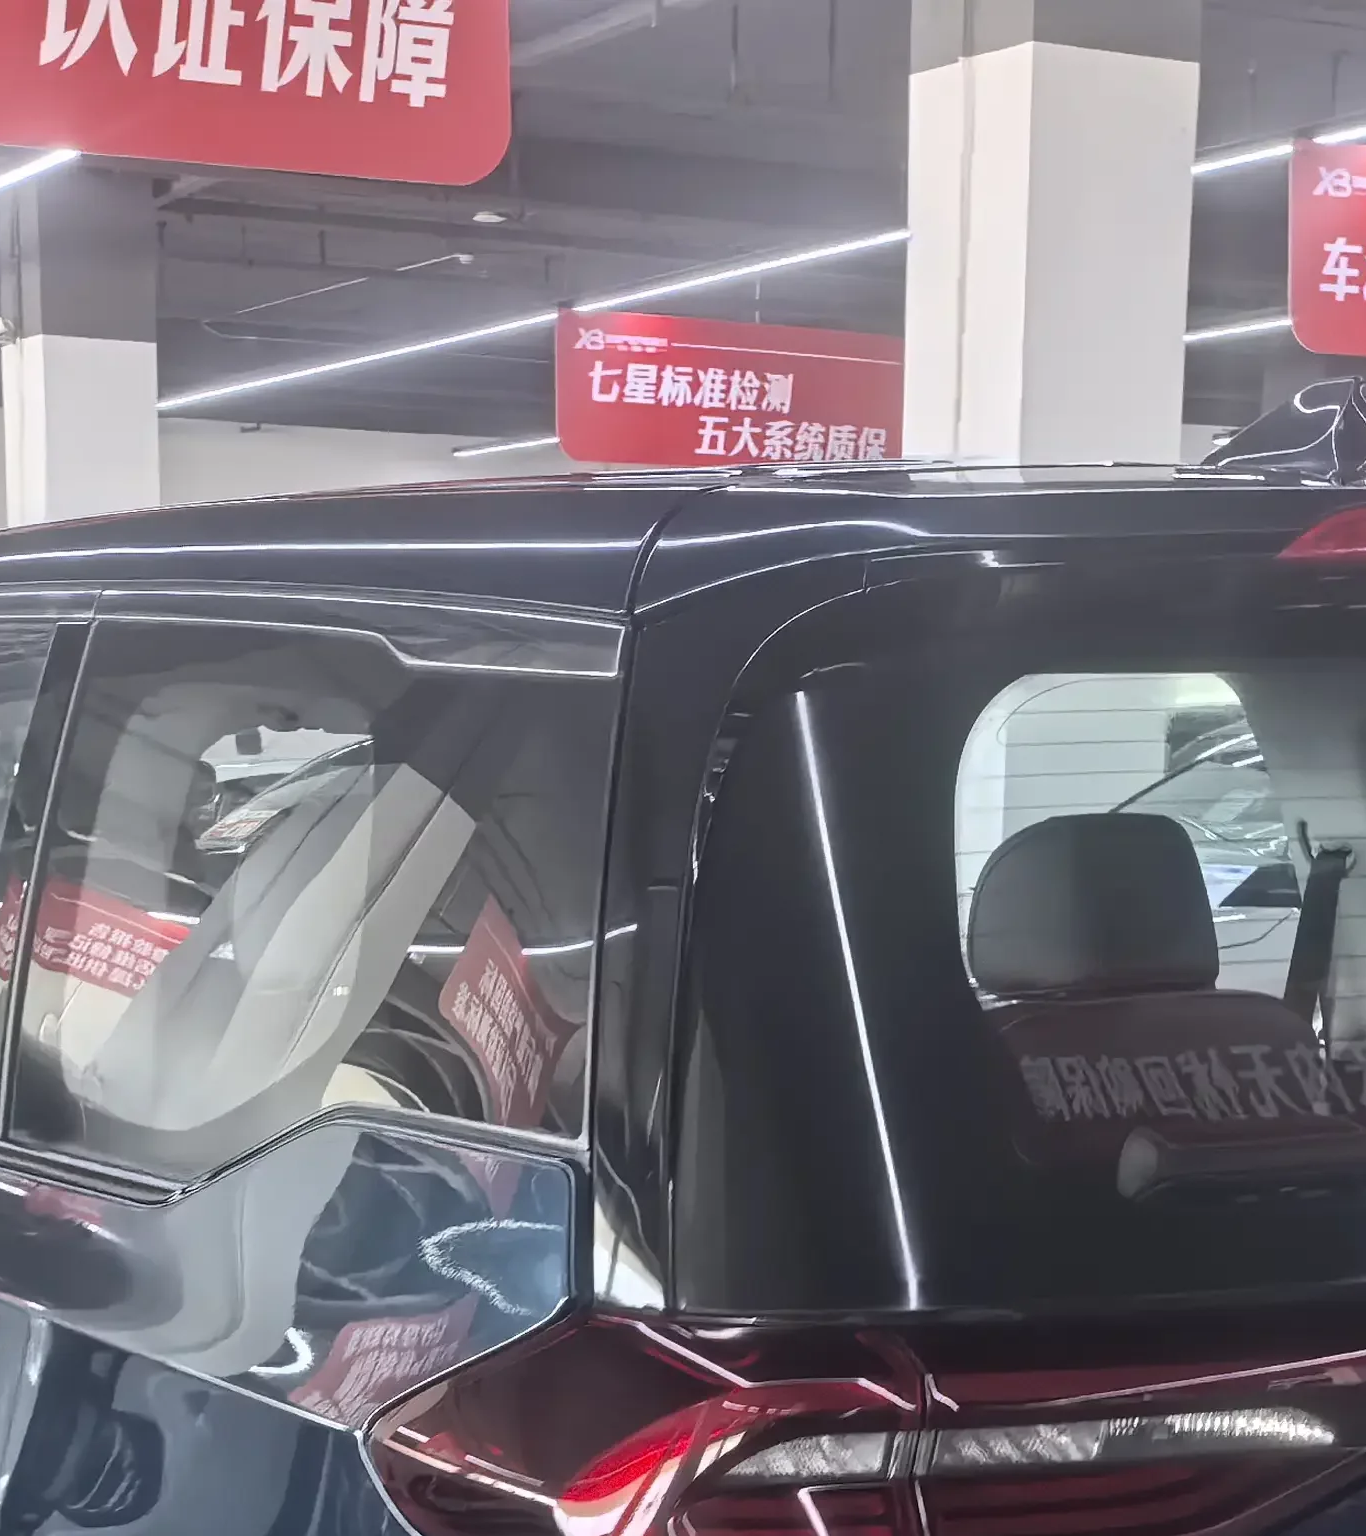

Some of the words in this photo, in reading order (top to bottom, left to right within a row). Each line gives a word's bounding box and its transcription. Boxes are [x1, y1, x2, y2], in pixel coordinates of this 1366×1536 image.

[588, 360, 794, 414] 七星标准检测
[694, 415, 888, 461] 五大系统质保
